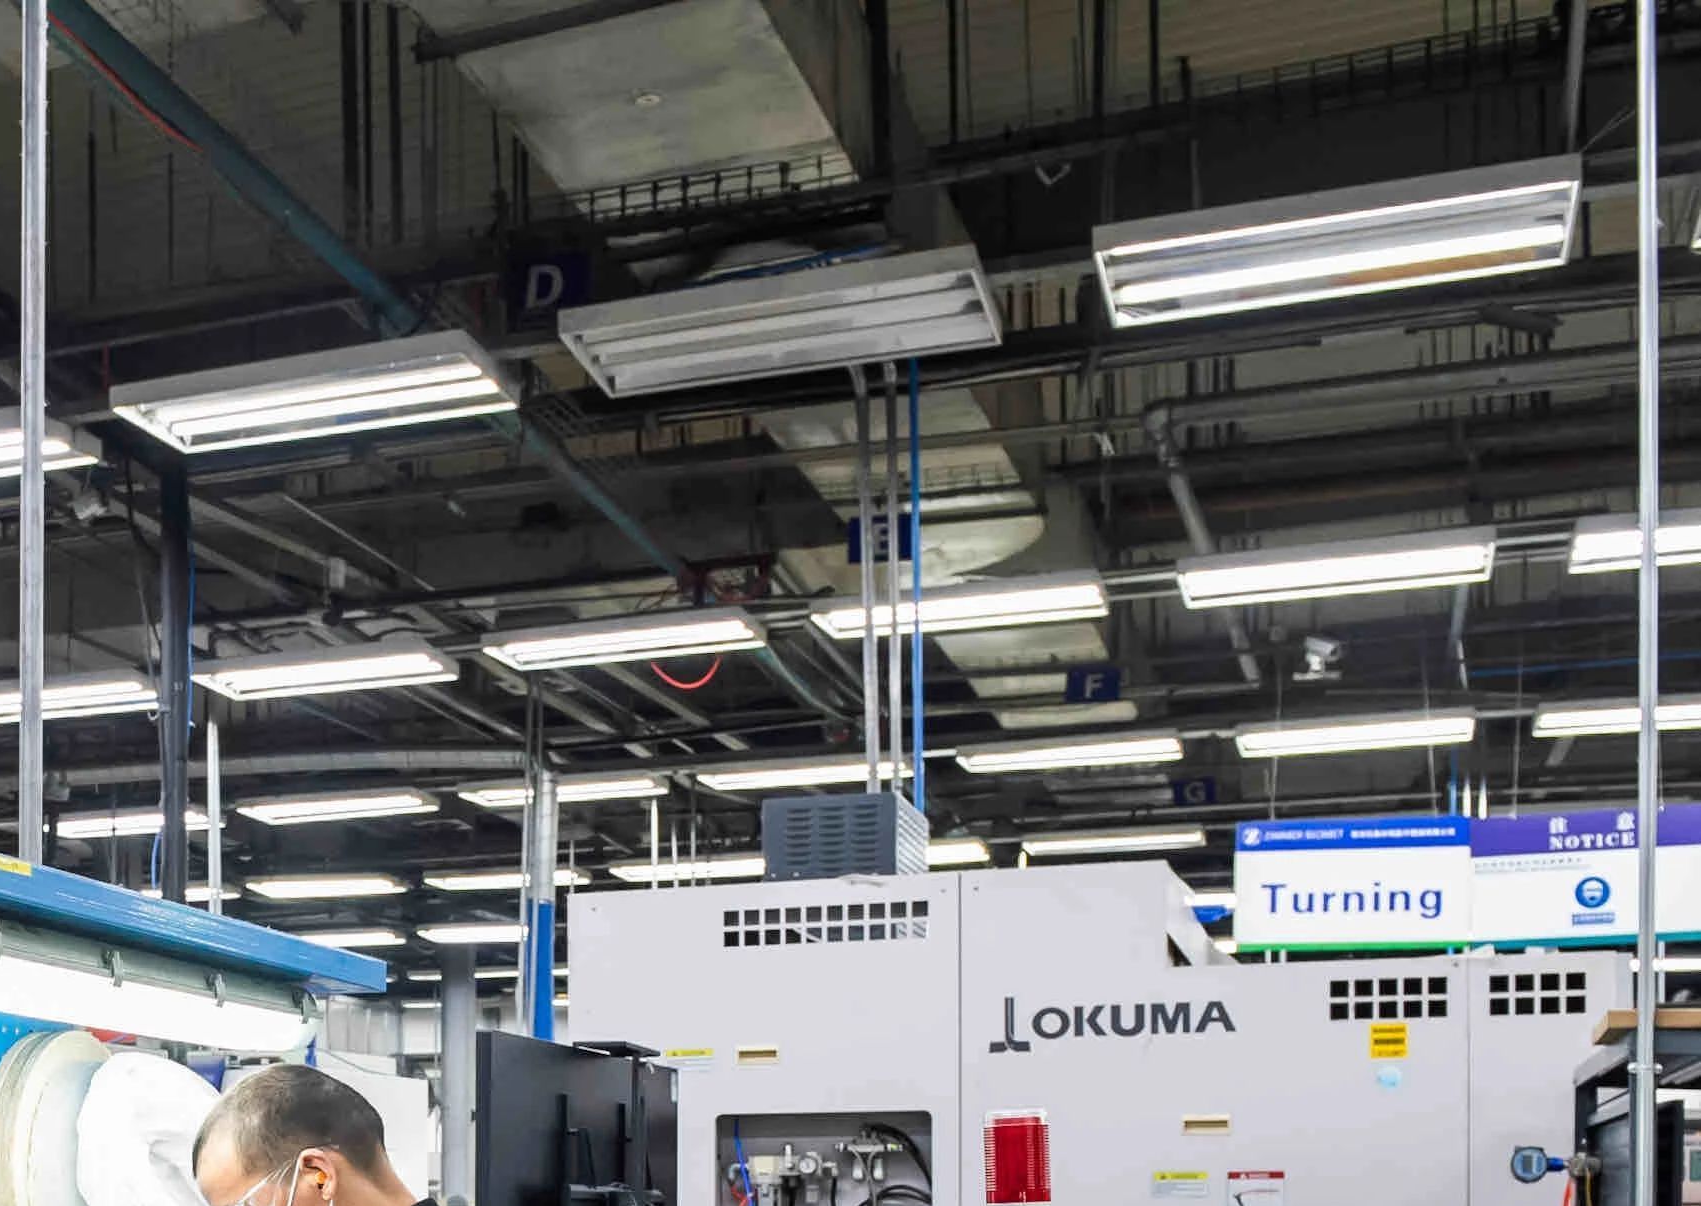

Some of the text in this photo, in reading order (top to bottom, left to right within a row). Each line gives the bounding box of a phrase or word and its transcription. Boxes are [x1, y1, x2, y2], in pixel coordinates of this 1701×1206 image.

[525, 264, 563, 308] D
[1084, 673, 1105, 699] F
[1184, 782, 1206, 804] G
[1549, 831, 1636, 851] NOTICE
[1261, 881, 1443, 919] Turning
[1032, 1001, 1236, 1039] OKUMA
